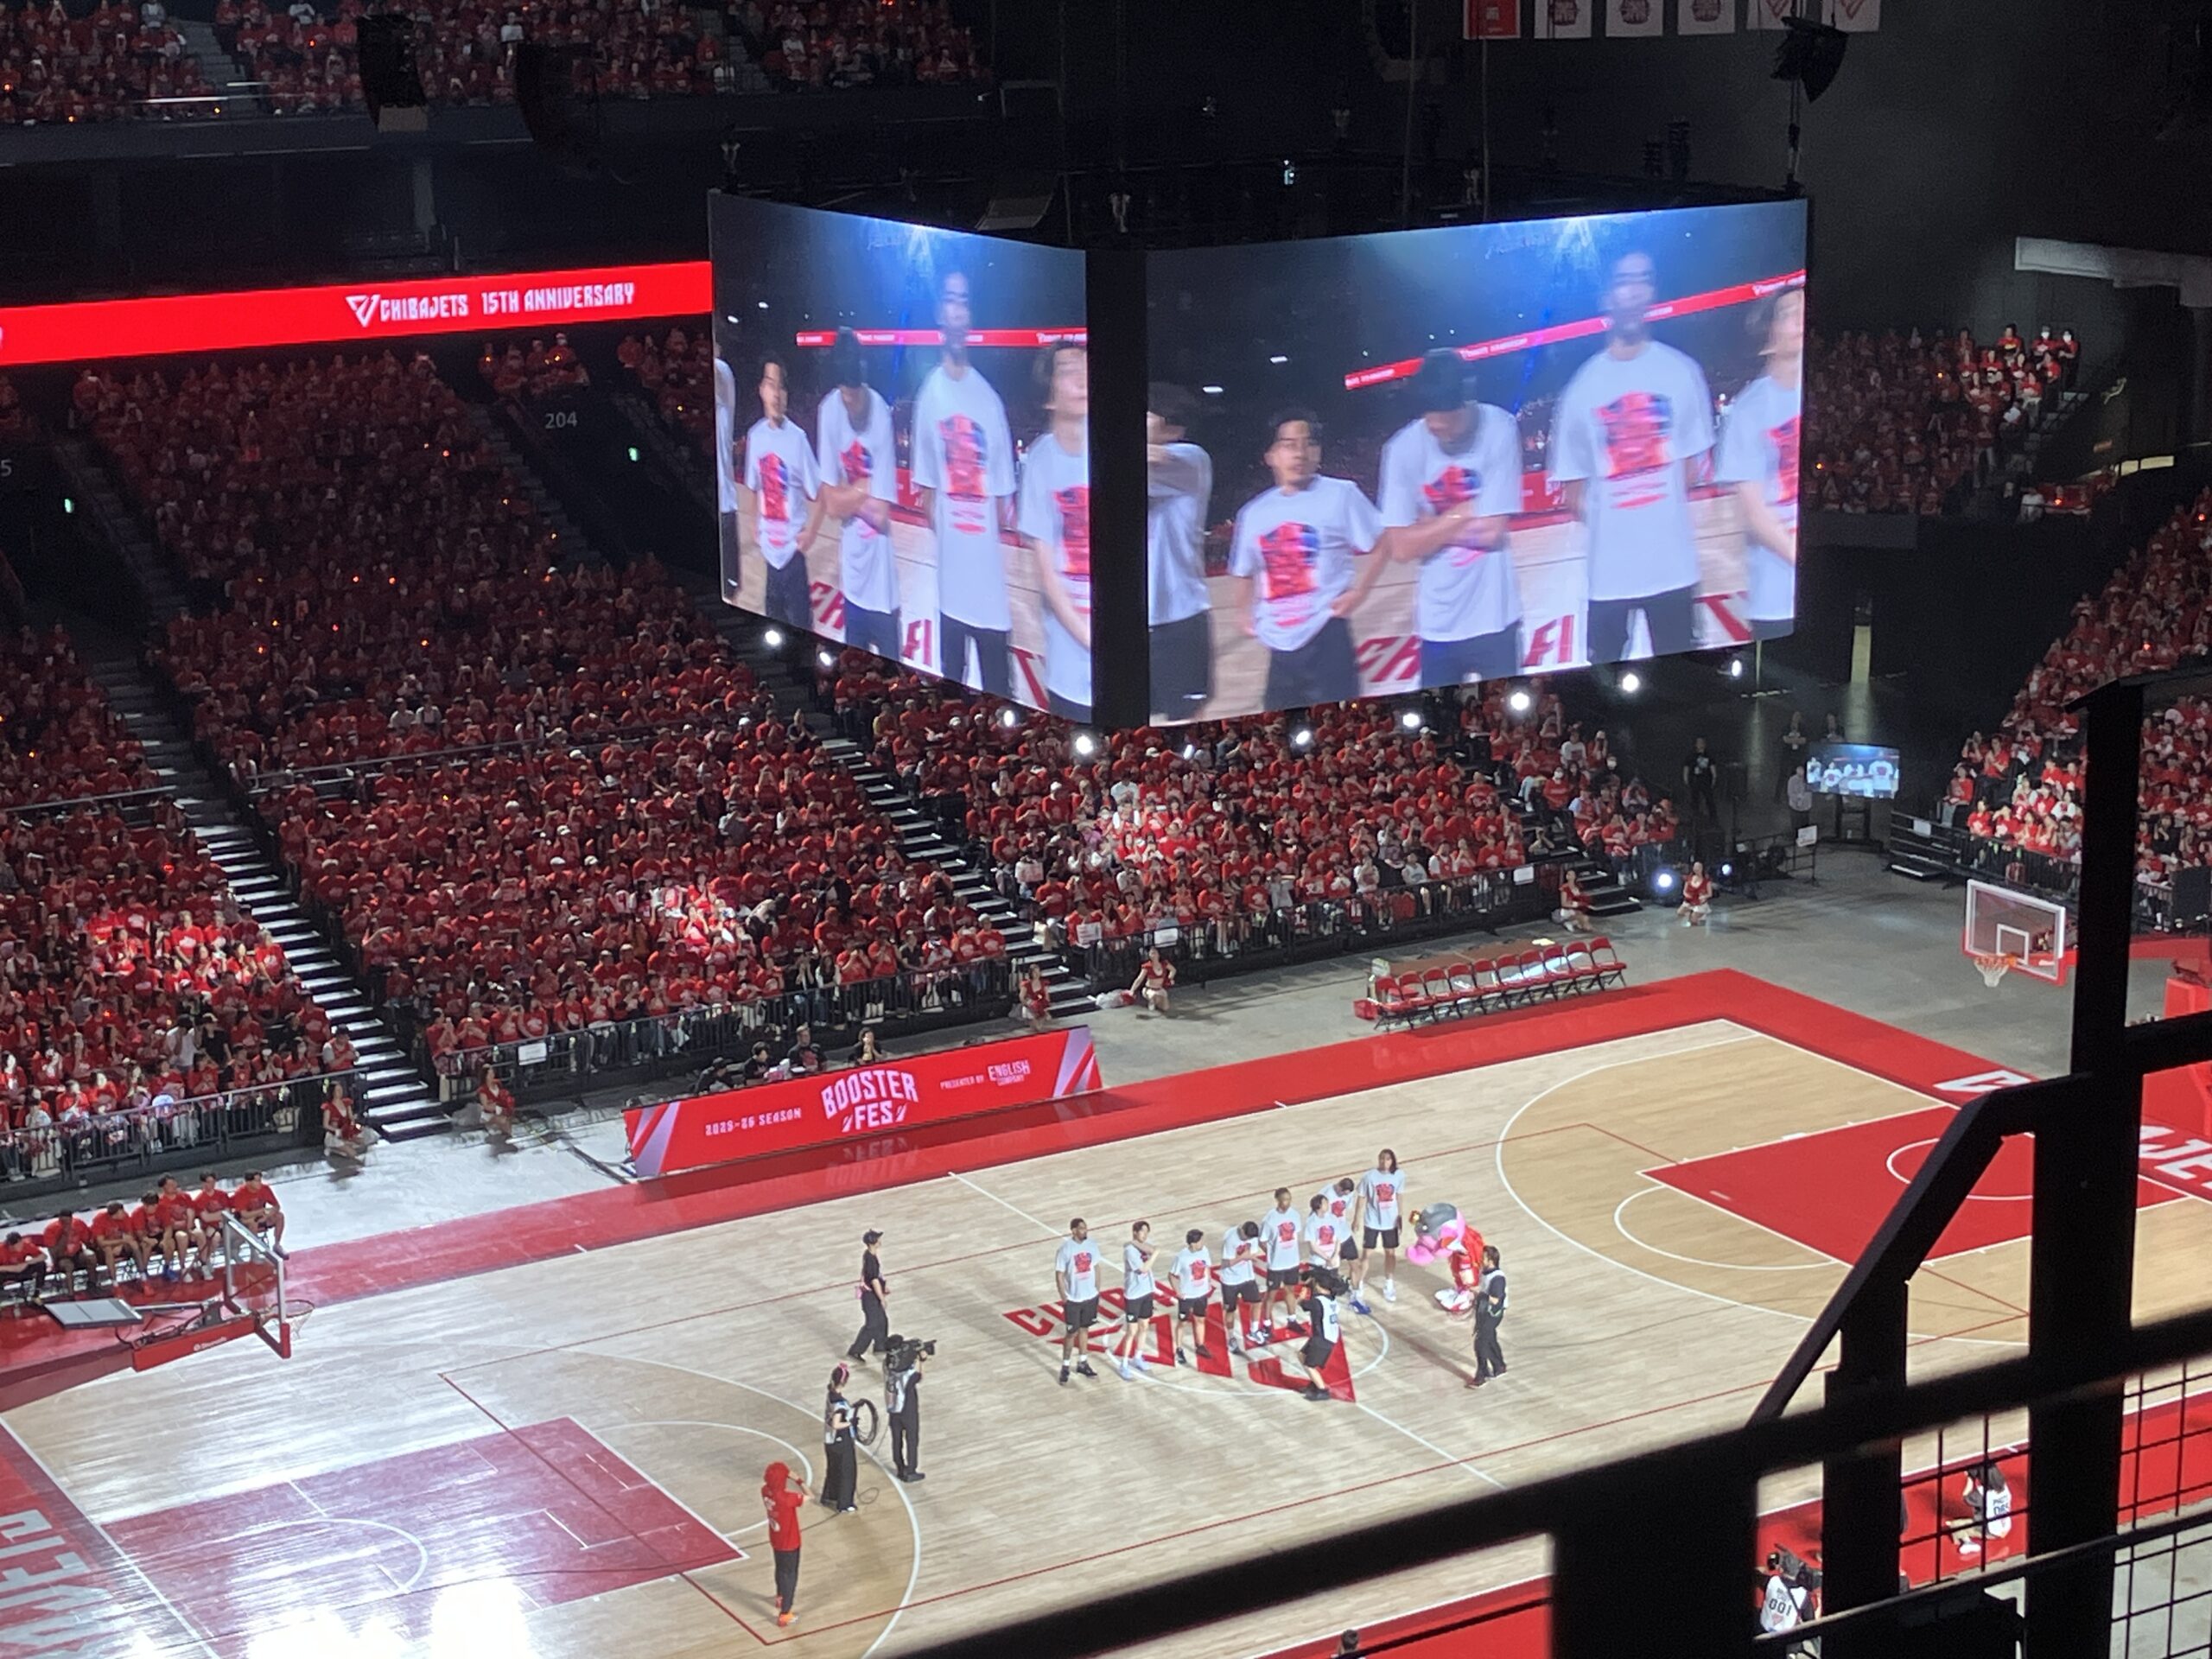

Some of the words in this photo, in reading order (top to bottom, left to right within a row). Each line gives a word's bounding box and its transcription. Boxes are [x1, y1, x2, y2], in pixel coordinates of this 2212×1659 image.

[480, 289, 519, 315] 15TH
[524, 282, 635, 312] ANNIVERSARY
[545, 411, 577, 429] 204
[988, 1059, 1030, 1082] ENGLISH
[821, 1069, 918, 1119] BOOSTER
[759, 1107, 802, 1127] SEASON
[855, 1101, 893, 1130] FES
[1769, 1598, 1792, 1617] 001
